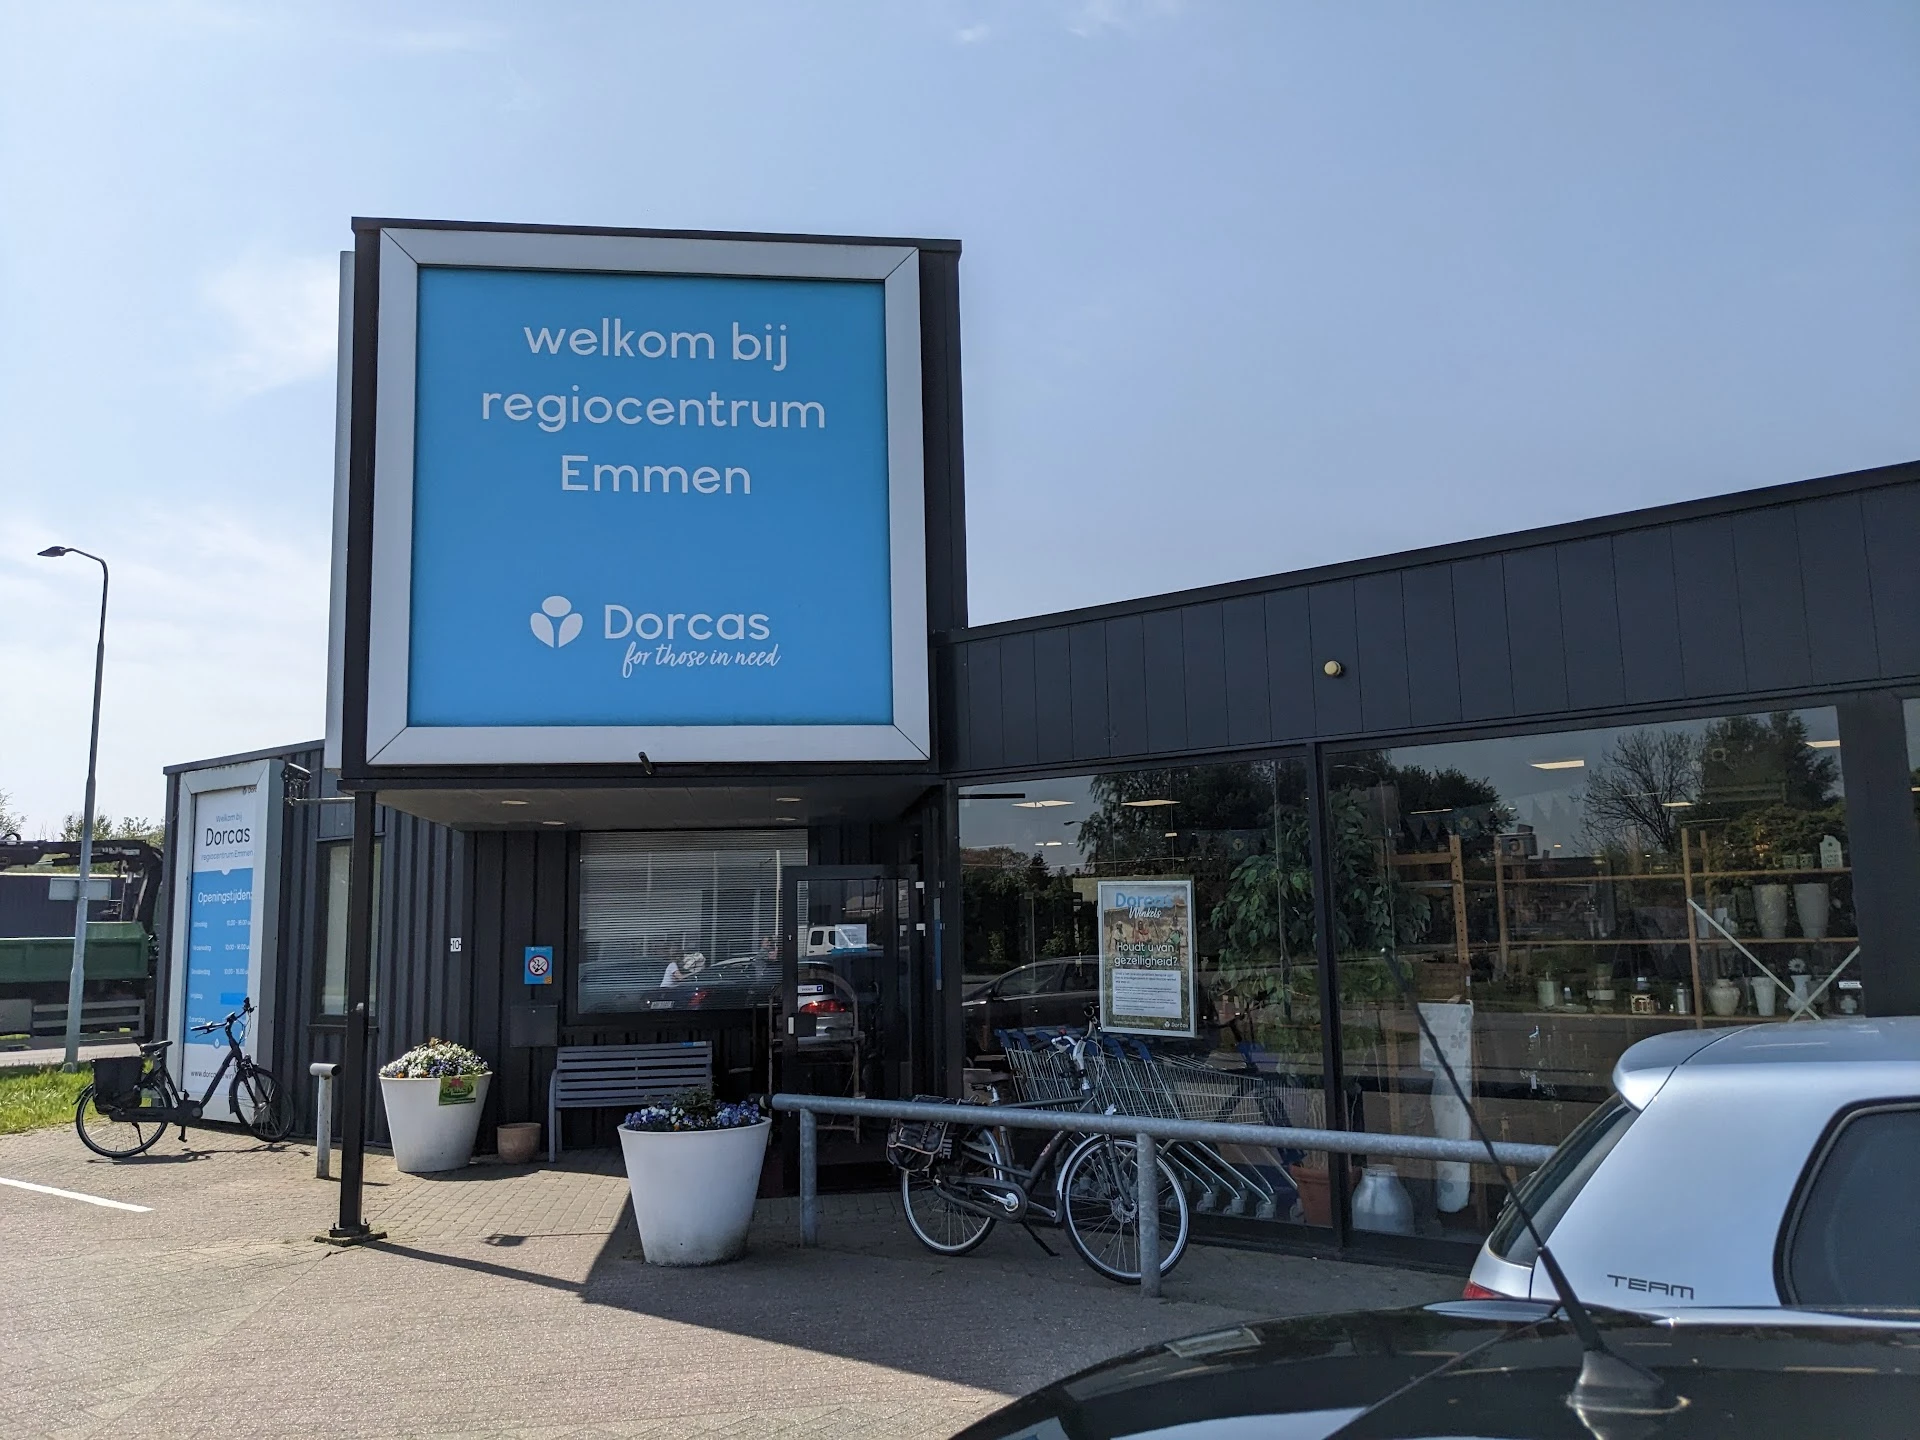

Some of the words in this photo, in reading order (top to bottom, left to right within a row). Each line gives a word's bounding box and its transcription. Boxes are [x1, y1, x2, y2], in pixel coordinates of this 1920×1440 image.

[524, 317, 715, 360] welkom
[732, 321, 787, 372] bij
[482, 385, 825, 433] regiocentrum
[561, 455, 751, 495] Emmen
[604, 604, 770, 640] Dorcas
[622, 641, 652, 679] for
[655, 643, 709, 668] those
[710, 649, 733, 667] in
[734, 643, 782, 667] need
[205, 827, 251, 847] Dorcas
[201, 851, 235, 863] regiocentrum
[235, 849, 253, 859] Emmen
[1129, 906, 1162, 919] Winkels
[1117, 942, 1146, 952] Houdt
[1148, 944, 1154, 952] u
[1156, 944, 1174, 952] van
[1114, 955, 1178, 968] gezelligheid?
[1607, 1274, 1694, 1300] TEAM
